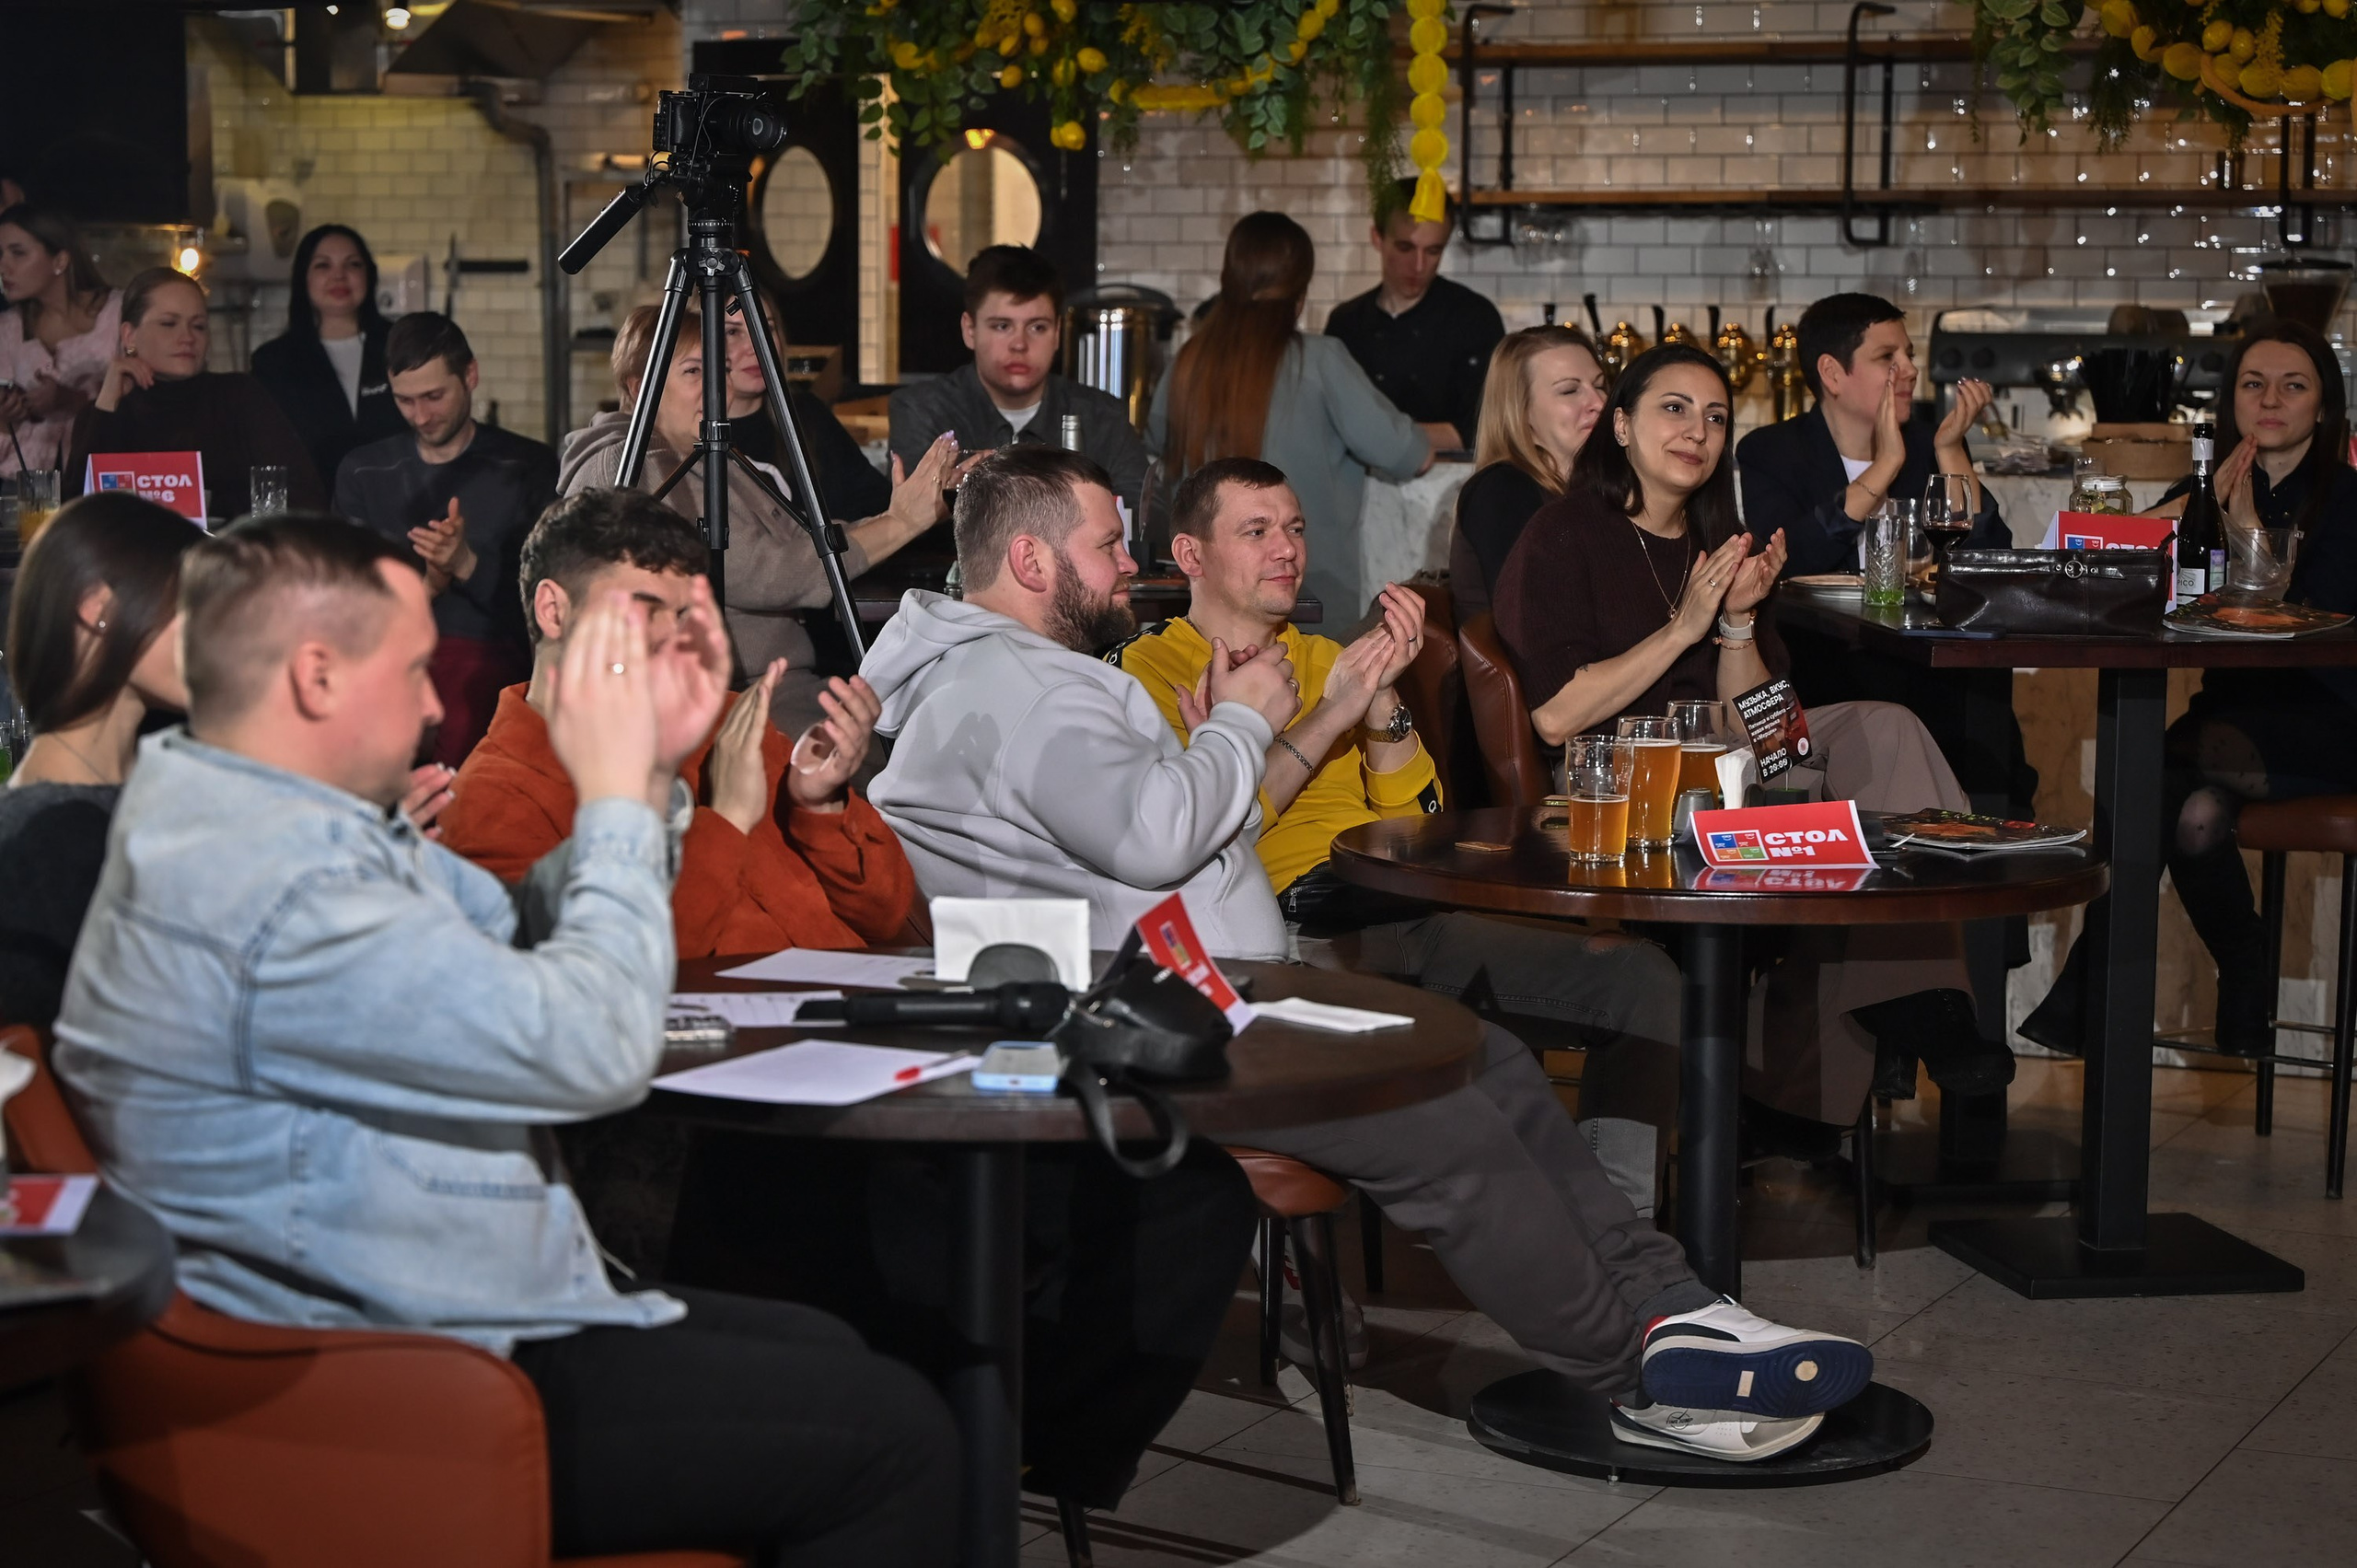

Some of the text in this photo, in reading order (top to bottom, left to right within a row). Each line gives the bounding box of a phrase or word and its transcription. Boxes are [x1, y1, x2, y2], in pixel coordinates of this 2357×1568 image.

[136, 473, 192, 488] СТОЛ
[1737, 679, 1790, 710] МУЗЫКА, ВКУС,
[1743, 693, 1784, 719] АТМОСФЕРА
[1759, 748, 1787, 767] НАЧАЛО
[1762, 758, 1788, 777] В 20:00
[1764, 829, 1848, 845] СТОЛ
[1769, 845, 1816, 857] №1
